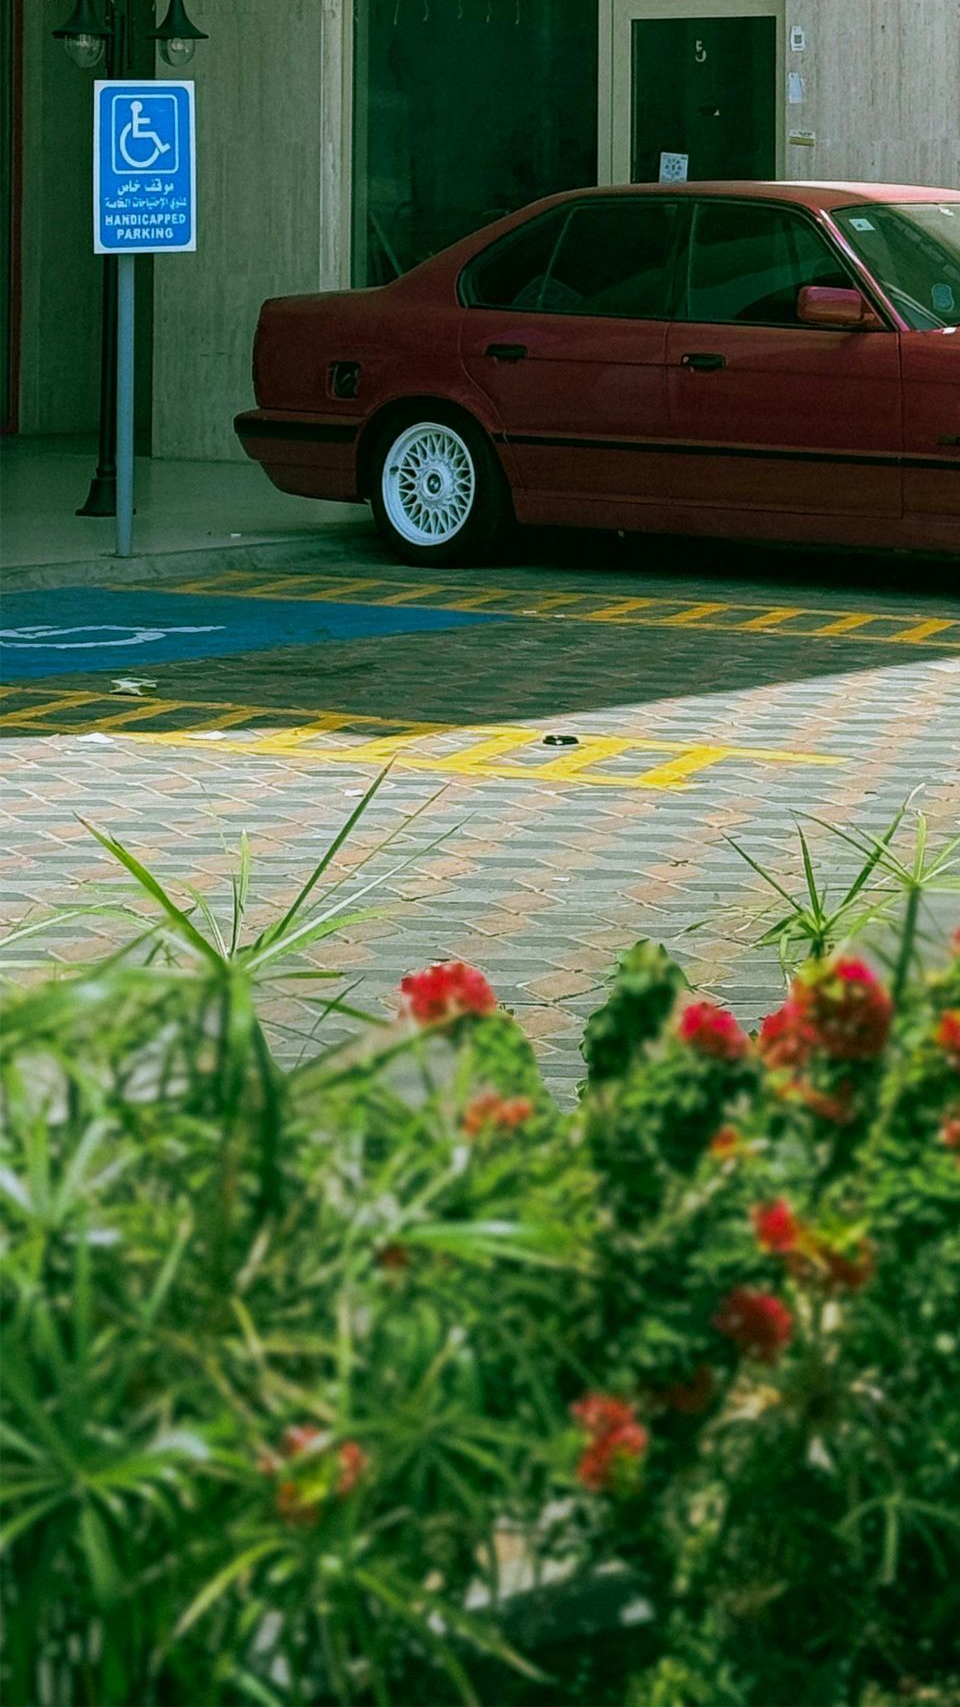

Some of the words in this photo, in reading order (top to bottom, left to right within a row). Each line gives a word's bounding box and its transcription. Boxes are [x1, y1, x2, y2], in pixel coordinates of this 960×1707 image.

[117, 179, 141, 196] خاص
[144, 177, 175, 195] موقف
[105, 213, 186, 226] HANDICAPPED
[116, 228, 174, 240] PARKING
